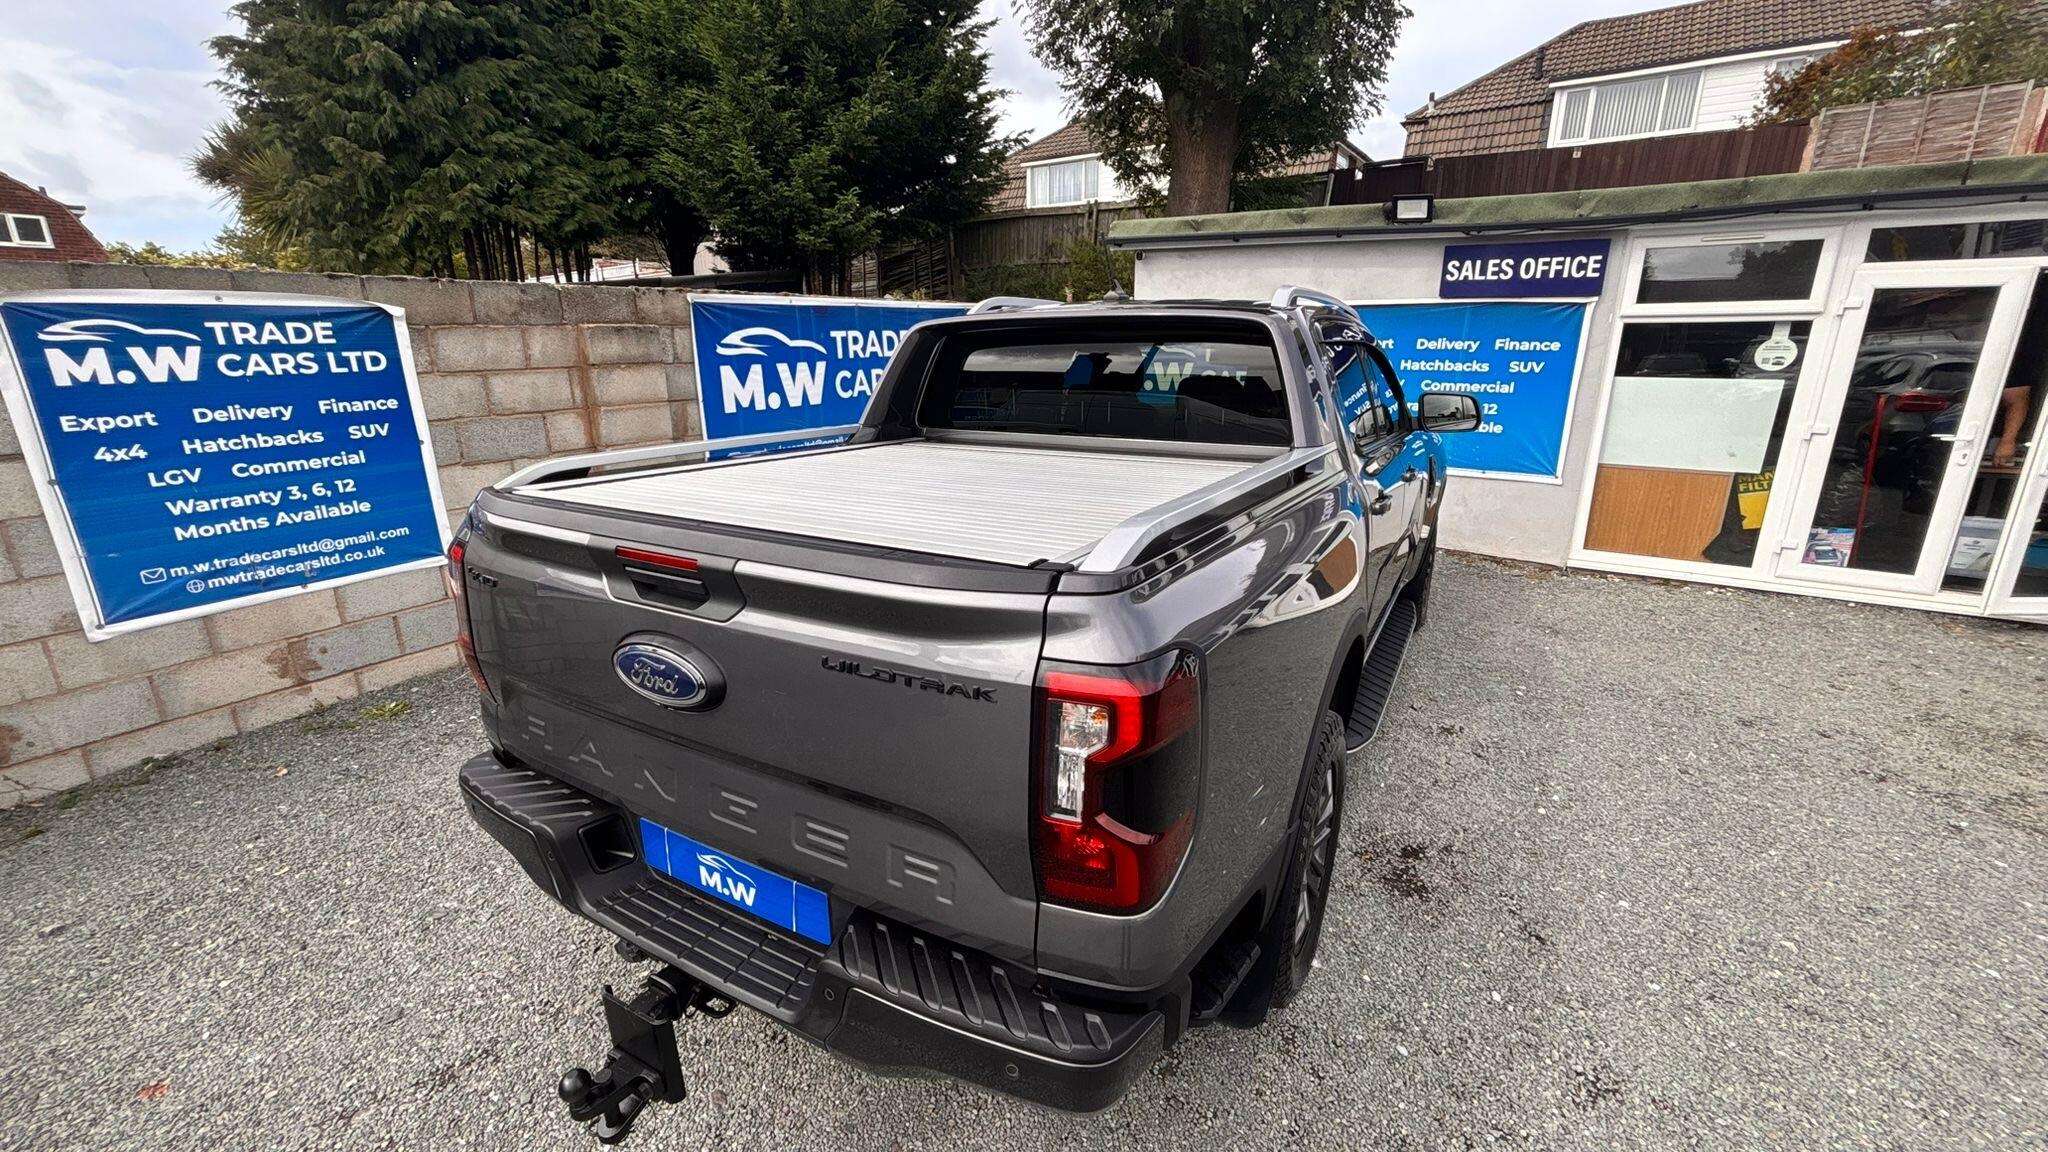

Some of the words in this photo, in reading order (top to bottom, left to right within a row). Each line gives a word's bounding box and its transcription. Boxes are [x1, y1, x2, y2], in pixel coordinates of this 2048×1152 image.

[1446, 258, 1514, 281] SALES
[1520, 255, 1602, 280] OFFICE
[204, 321, 337, 346] TRADE
[1416, 338, 1480, 351] Delivery
[1495, 338, 1561, 351] Finance
[44, 345, 201, 386] M.W
[217, 351, 319, 377] CARS
[327, 350, 387, 373] LTD
[1401, 358, 1490, 373] Hatchbacks
[1509, 361, 1545, 373] SUV
[719, 361, 826, 414] M.W
[835, 368, 886, 399] CAR
[1421, 380, 1514, 394] Commercial
[59, 411, 158, 433] Export
[192, 405, 293, 424] Delivery
[318, 396, 399, 414] Finance
[1483, 404, 1498, 415] 12
[94, 443, 148, 462] 4x4
[182, 429, 325, 455] Hatchbacks
[348, 423, 389, 440] SUV
[148, 467, 201, 488] LGV
[231, 450, 366, 478] Commercial
[1739, 480, 1770, 492] FILT
[165, 490, 282, 516] Warranty
[286, 485, 308, 501] 3,
[311, 482, 332, 497] 6,
[334, 479, 357, 494] 12
[174, 516, 270, 541] Months
[275, 500, 372, 526] Available
[170, 525, 410, 578] m.w.tradecarsltd@gmail.com
[208, 546, 385, 589] mwtradecarsltd.co.uk
[630, 656, 680, 695] Ford
[821, 655, 998, 704] WILDTRAK
[520, 714, 957, 906] RANGER
[699, 864, 757, 907] M.W
